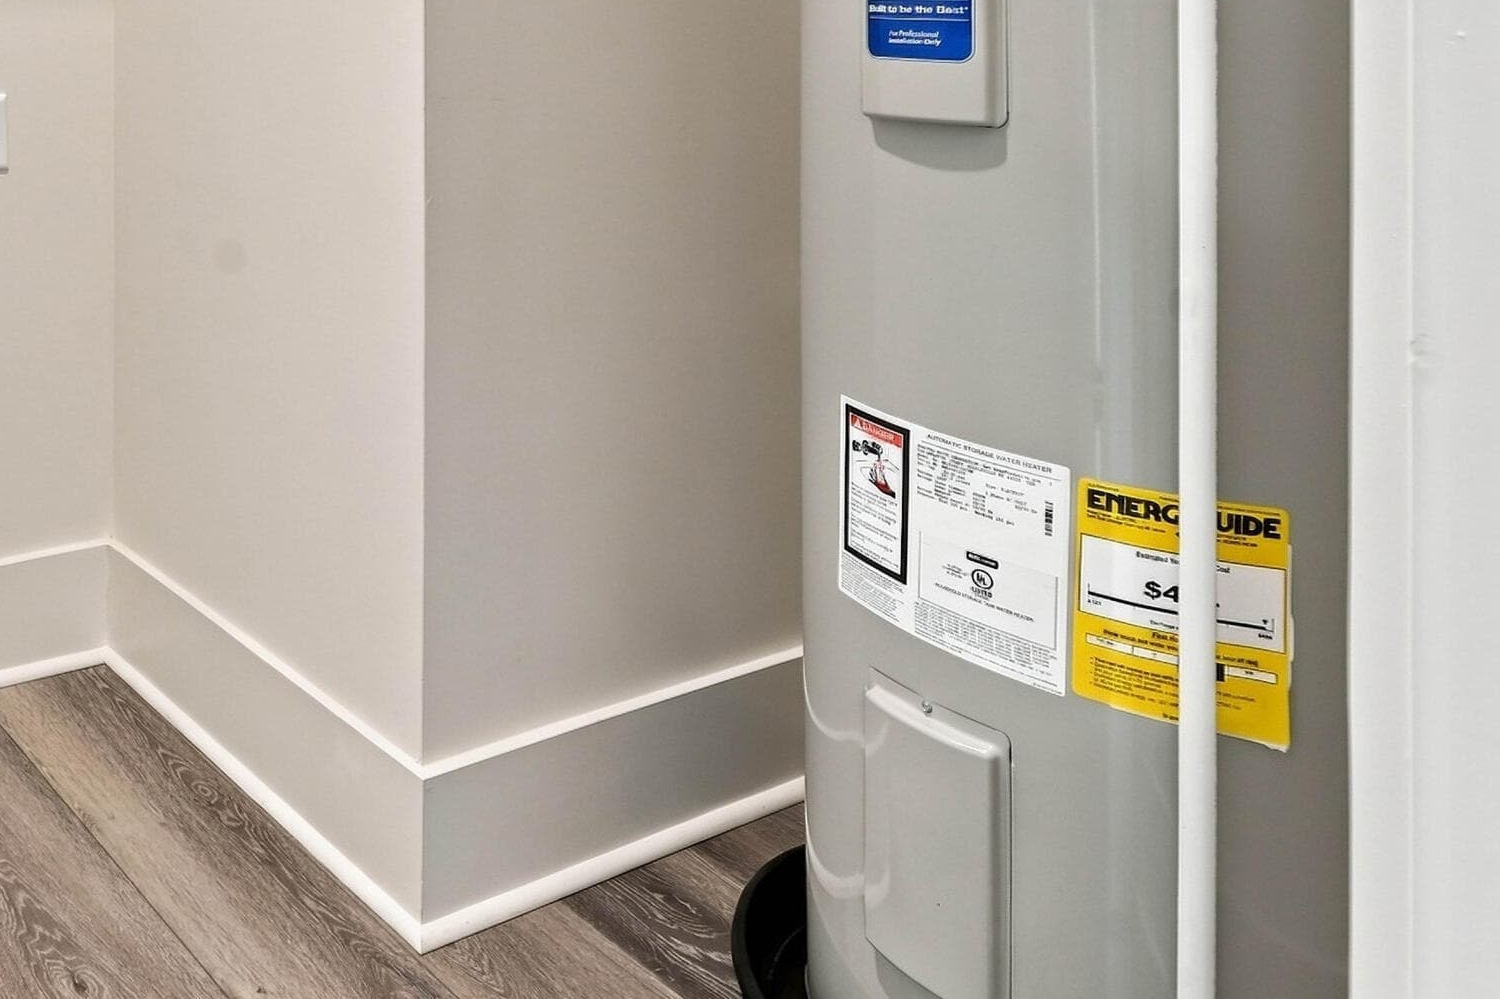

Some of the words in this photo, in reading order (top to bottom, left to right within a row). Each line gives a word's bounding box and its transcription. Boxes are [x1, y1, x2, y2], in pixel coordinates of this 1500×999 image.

[869, 4, 886, 13] Built
[888, 5, 897, 13] to
[900, 5, 912, 14] be
[915, 5, 933, 14] the
[898, 30, 939, 38] Professional
[923, 38, 941, 47] Only
[927, 434, 962, 450] AUTOMATIC
[963, 445, 994, 460] STORAGE
[996, 454, 1021, 467] WATER
[1022, 462, 1053, 474] HEATER
[1087, 487, 1281, 540] ENERGUIDE
